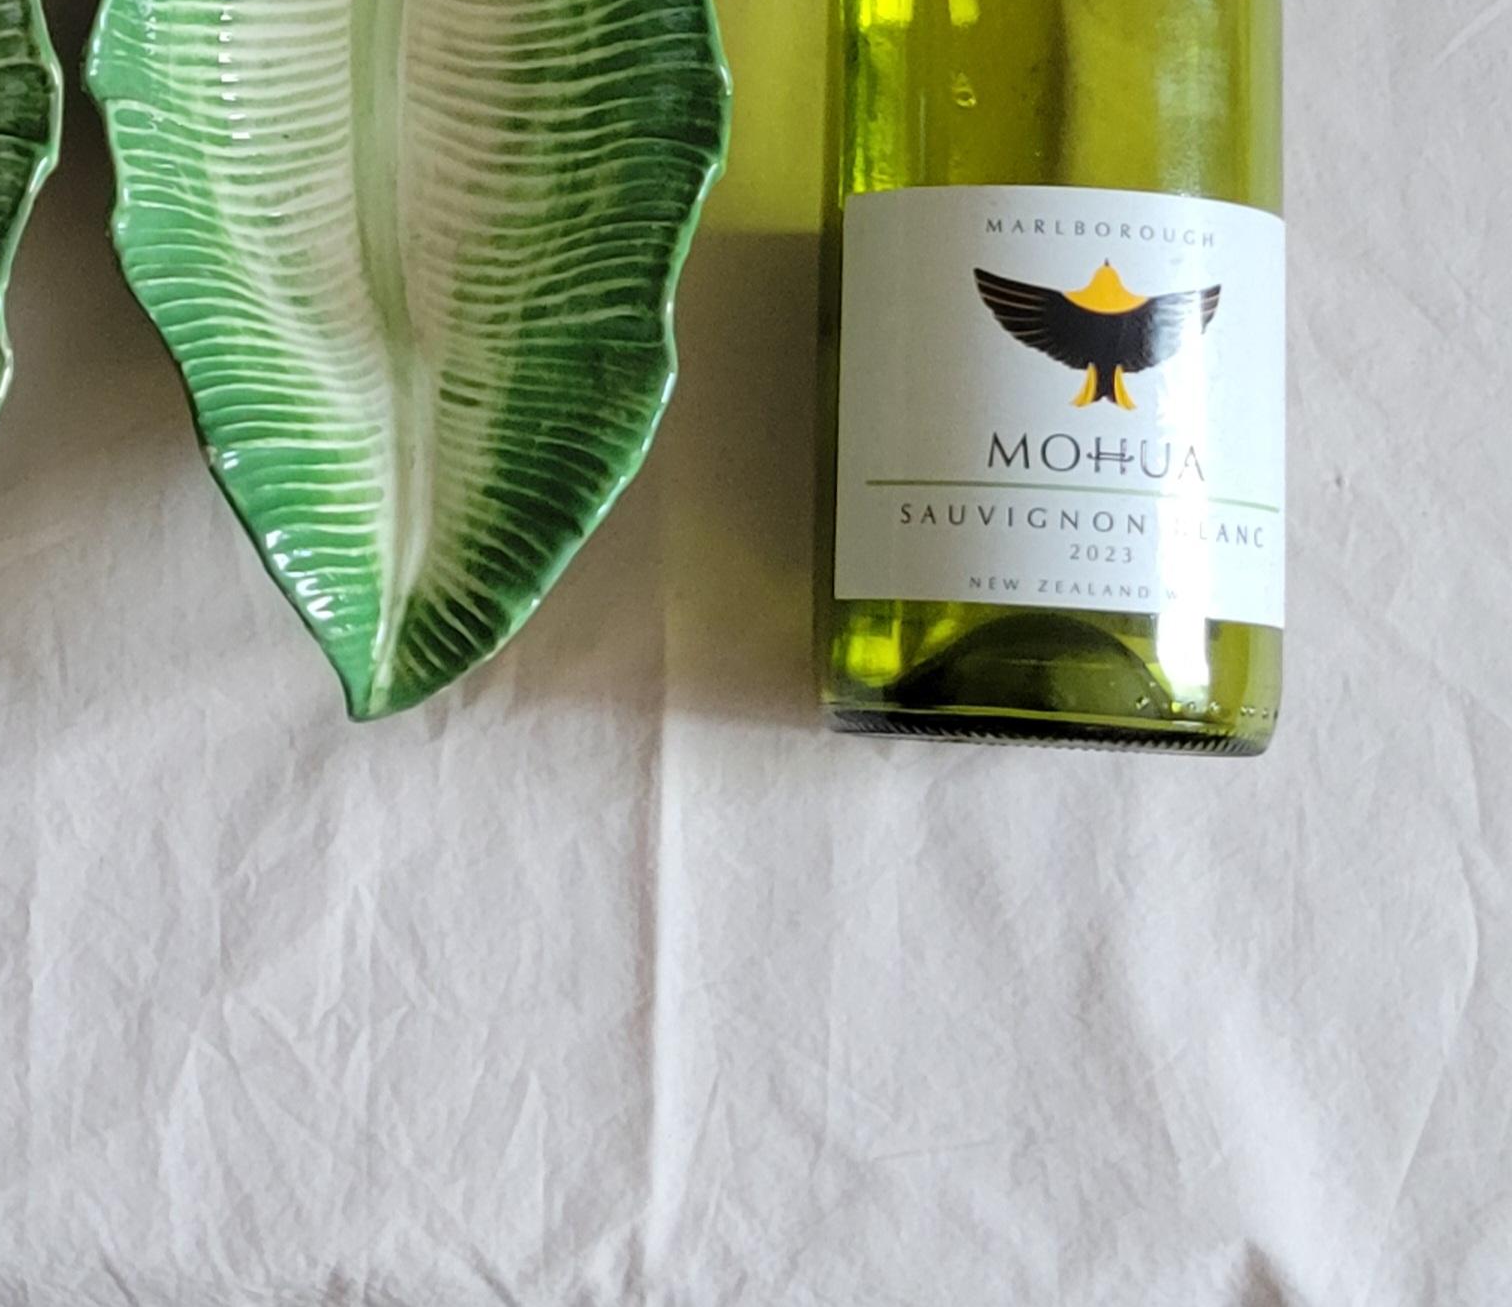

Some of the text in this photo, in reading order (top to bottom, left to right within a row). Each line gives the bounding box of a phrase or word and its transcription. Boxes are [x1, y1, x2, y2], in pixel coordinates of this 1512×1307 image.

[985, 218, 1215, 248] MARLBOROUGH
[987, 431, 1205, 481] MOHUA
[899, 503, 1265, 549] SAUVIGNON LANC
[1068, 543, 1134, 564] 2023
[969, 575, 1020, 591] NEW
[1037, 578, 1151, 600] ZEALAND
